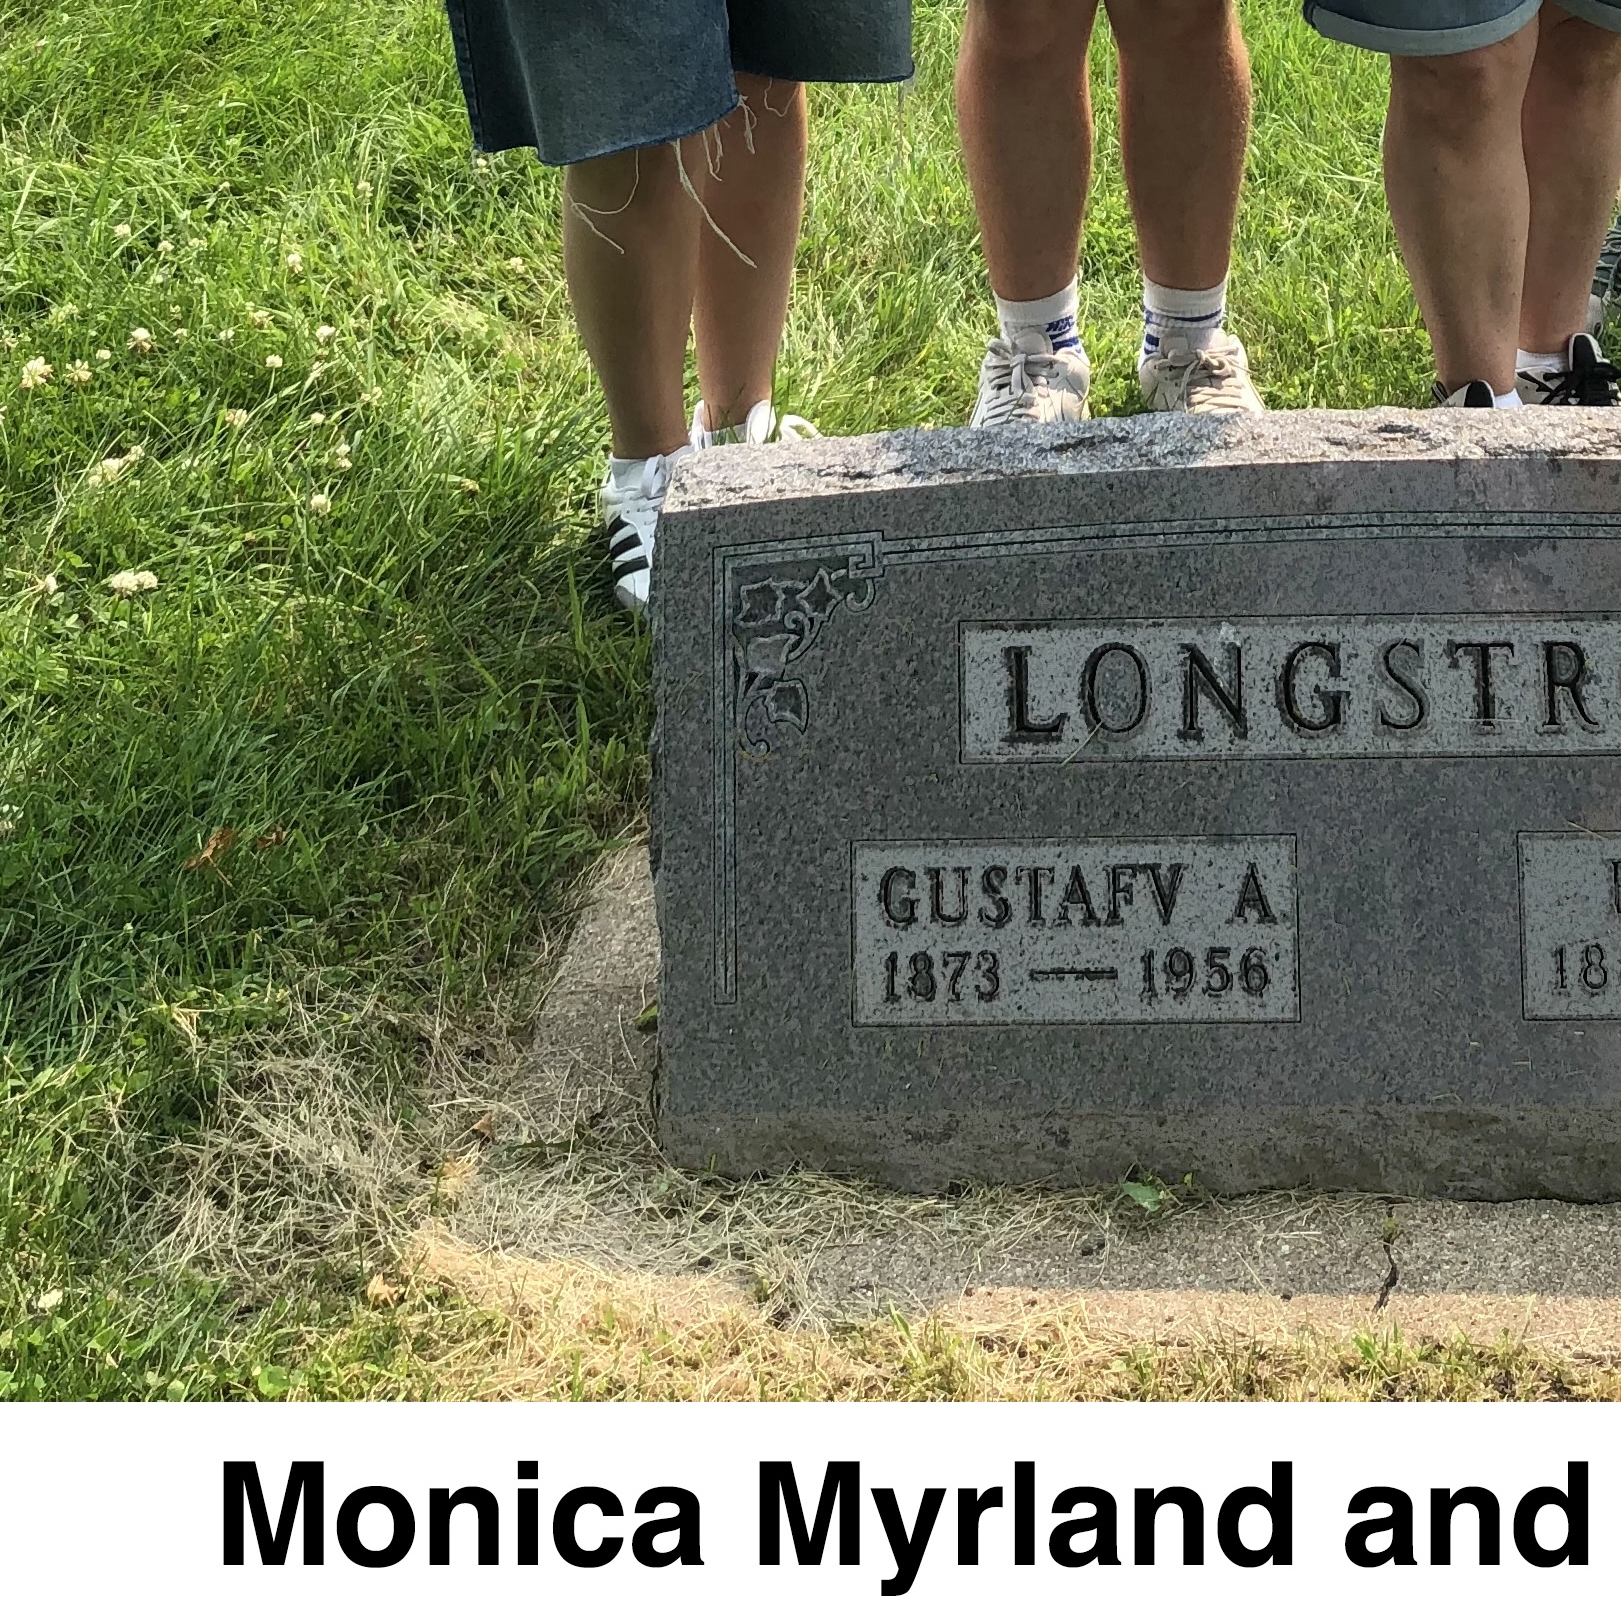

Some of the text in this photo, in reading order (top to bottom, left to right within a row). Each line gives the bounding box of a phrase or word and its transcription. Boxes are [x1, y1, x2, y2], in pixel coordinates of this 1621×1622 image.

[880, 861, 1279, 929] GUSTAFV A
[884, 950, 1001, 1004] 1873
[1141, 945, 1273, 1002] 1956
